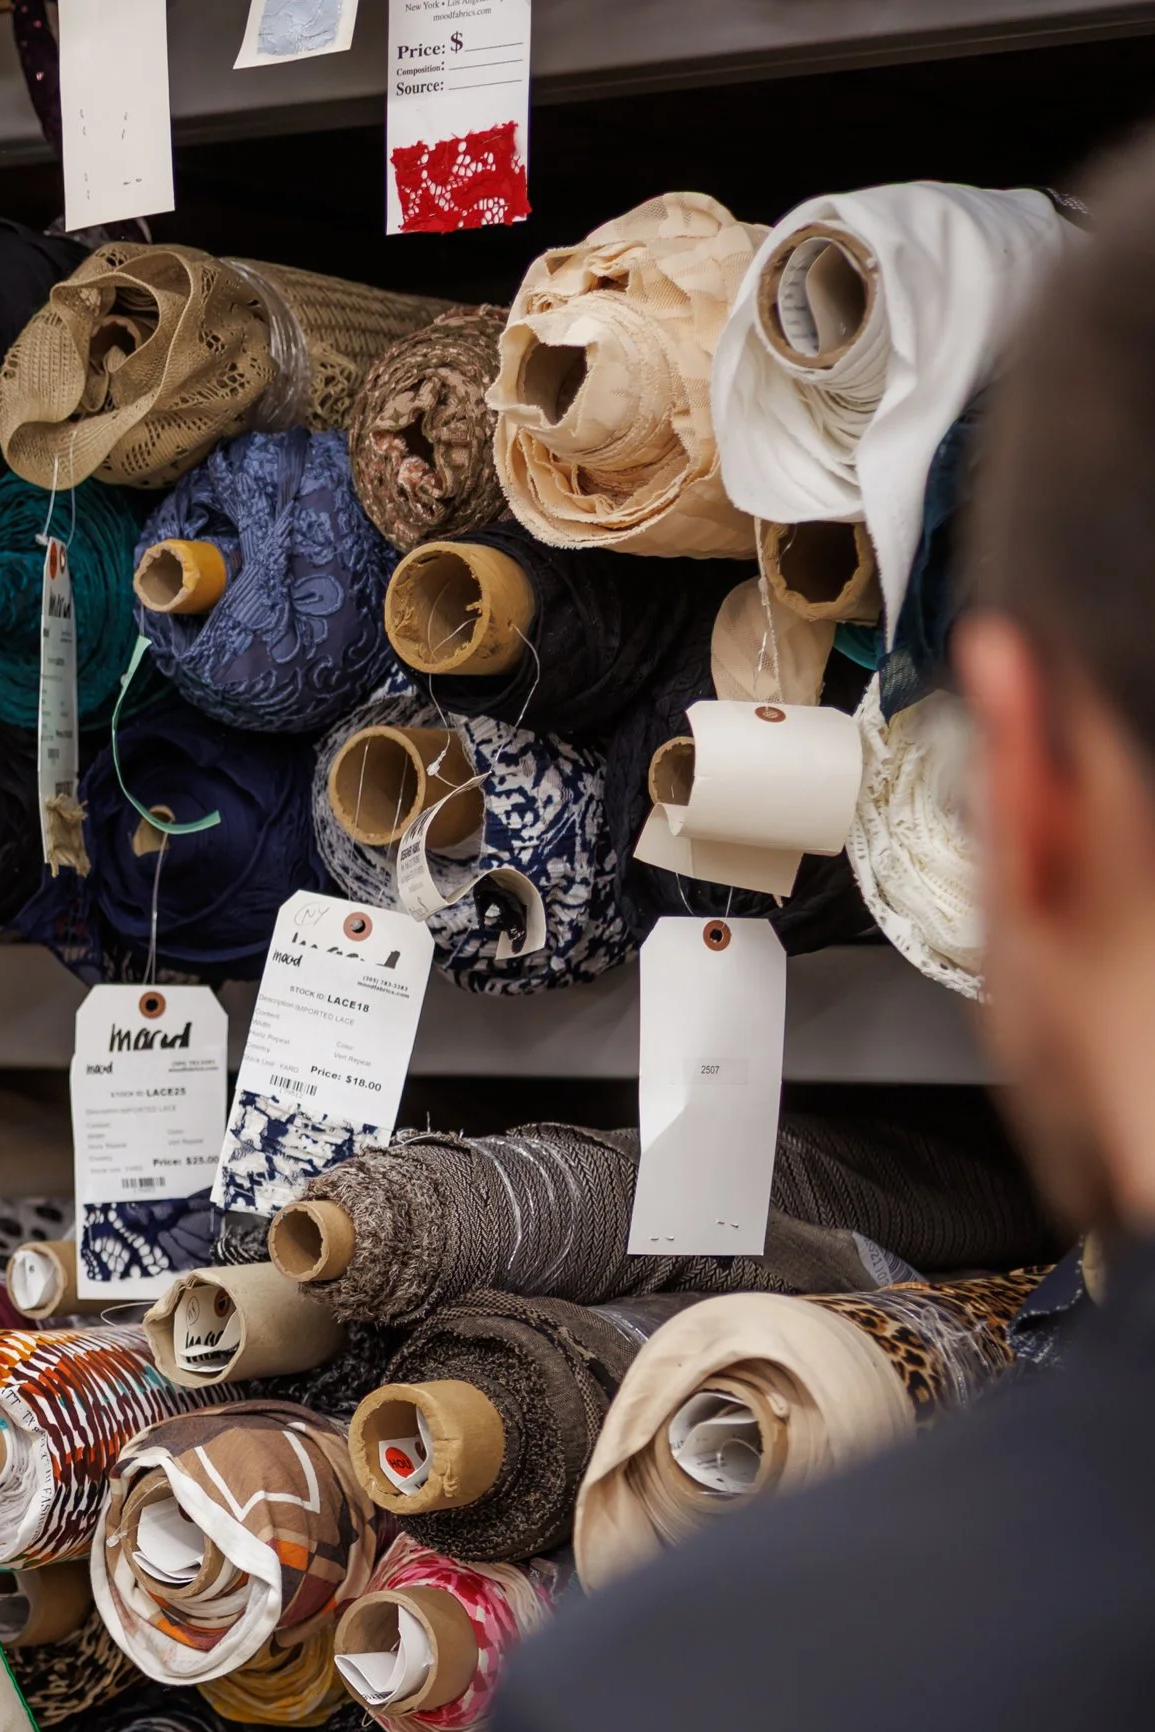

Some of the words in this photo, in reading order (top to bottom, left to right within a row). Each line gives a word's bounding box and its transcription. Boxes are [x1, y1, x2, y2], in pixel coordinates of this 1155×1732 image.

[405, 4, 421, 12] New
[423, 1, 440, 10] York
[433, 8, 492, 21] moodfabrics.com
[397, 43, 446, 60] Price:
[450, 31, 464, 54] $
[396, 61, 445, 76] Composition:
[396, 81, 444, 96] Source:
[272, 949, 303, 968] mood
[357, 981, 410, 999] moodfabrics.com
[289, 985, 315, 998] STOCK
[327, 994, 370, 1013] LACE18
[295, 1004, 334, 1021] IMPORTED
[335, 1015, 355, 1026] LACE
[86, 1061, 113, 1075] mood
[701, 1065, 720, 1075] 2507
[310, 1065, 341, 1080] Price:
[345, 1075, 382, 1092] $18.00
[146, 1087, 187, 1098] LACE25
[152, 1157, 182, 1167] Price:
[185, 1155, 220, 1166] $25.00
[390, 1458, 412, 1469] HOU
